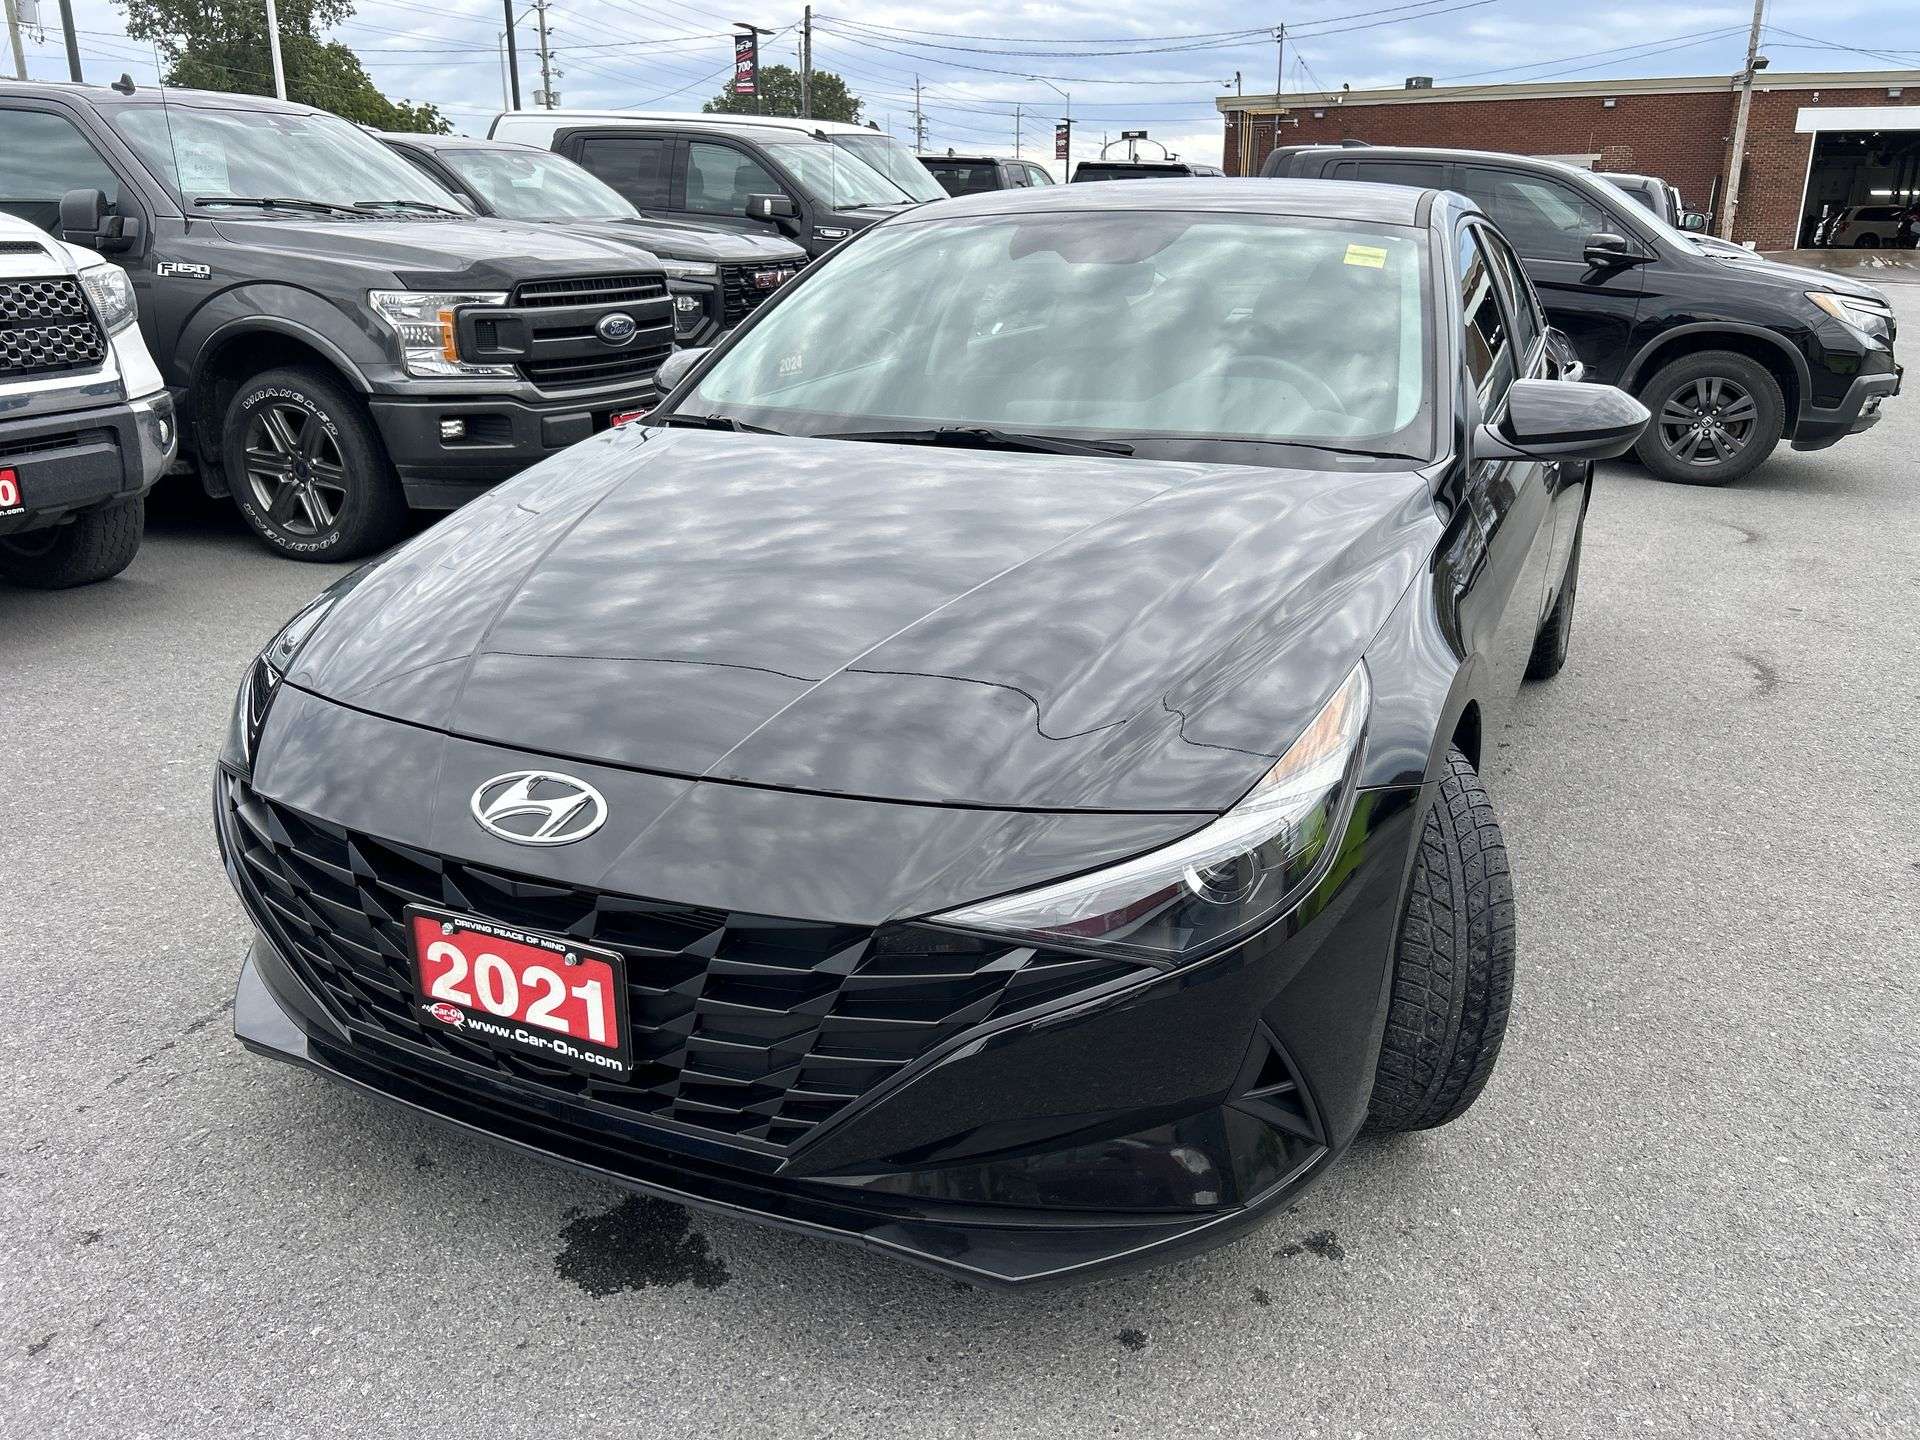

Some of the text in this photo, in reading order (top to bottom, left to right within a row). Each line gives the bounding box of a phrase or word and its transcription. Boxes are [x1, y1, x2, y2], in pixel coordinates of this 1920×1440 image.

[610, 320, 631, 335] Ford
[242, 387, 338, 435] WRANGLER
[454, 918, 567, 953] DRIVING PEACE OF MIND
[427, 941, 606, 1044] 2021
[467, 1017, 623, 1072] www.Car-On.com
